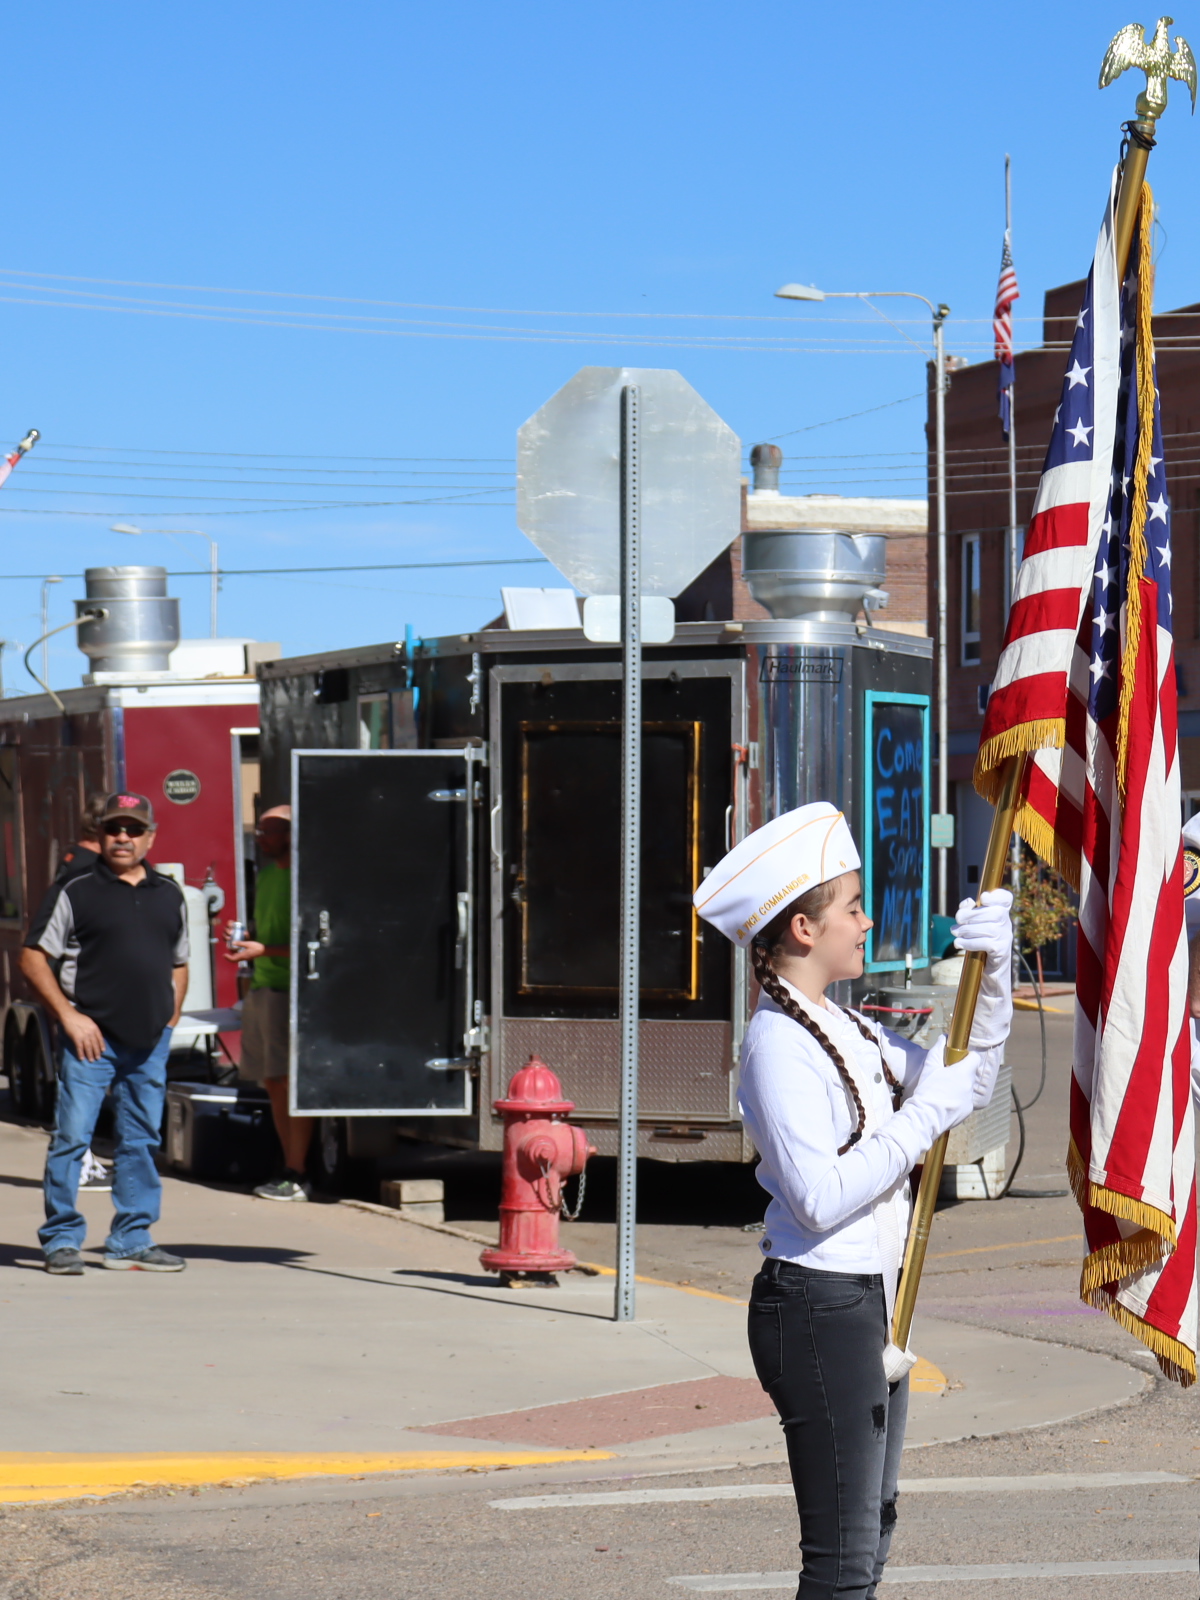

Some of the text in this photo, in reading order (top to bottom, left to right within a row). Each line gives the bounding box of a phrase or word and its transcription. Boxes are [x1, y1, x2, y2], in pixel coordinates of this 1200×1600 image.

[769, 661, 835, 675] Haulmark
[877, 727, 923, 778] Come
[877, 786, 922, 841] EAT
[743, 912, 762, 931] VICE
[758, 873, 811, 916] COMMANDER
